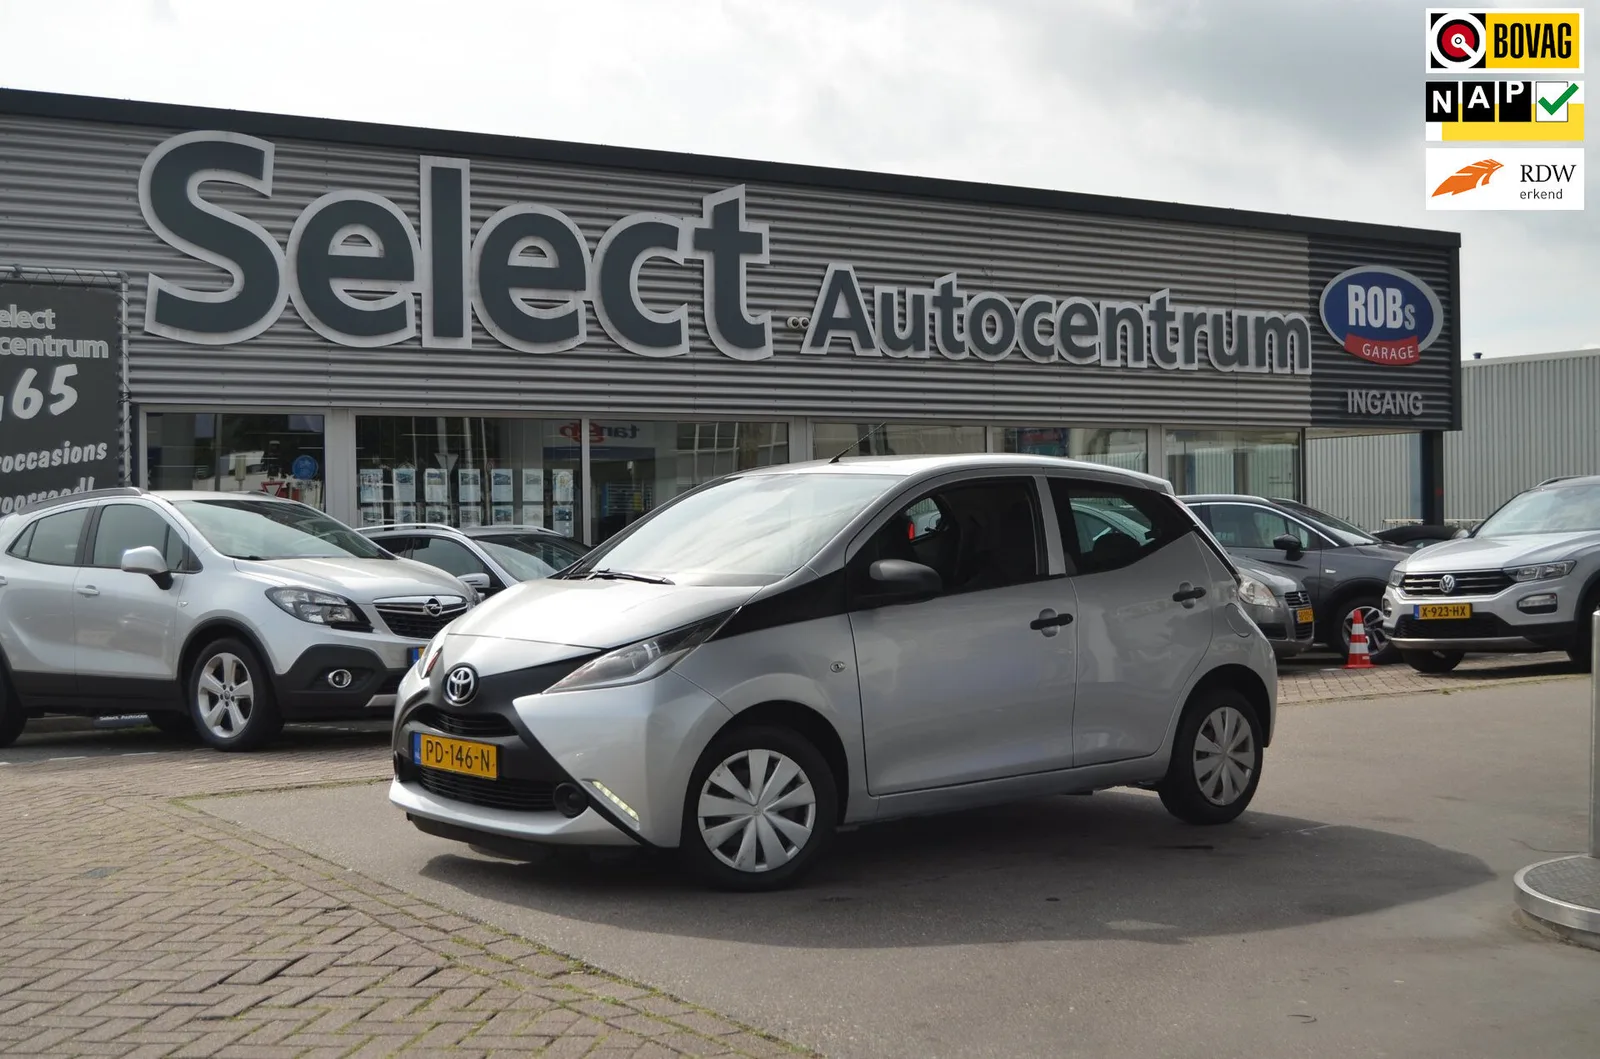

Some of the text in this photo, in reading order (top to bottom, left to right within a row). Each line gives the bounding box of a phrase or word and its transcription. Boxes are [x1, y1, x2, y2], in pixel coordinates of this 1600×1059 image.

[138, 130, 1312, 375] Select Autocentrum
[1362, 343, 1415, 360] GARAGE
[1347, 389, 1424, 416] INGANG
[0, 440, 108, 473] occasions
[1421, 605, 1466, 618] X-923-HX
[426, 740, 490, 772] PD-146-N
